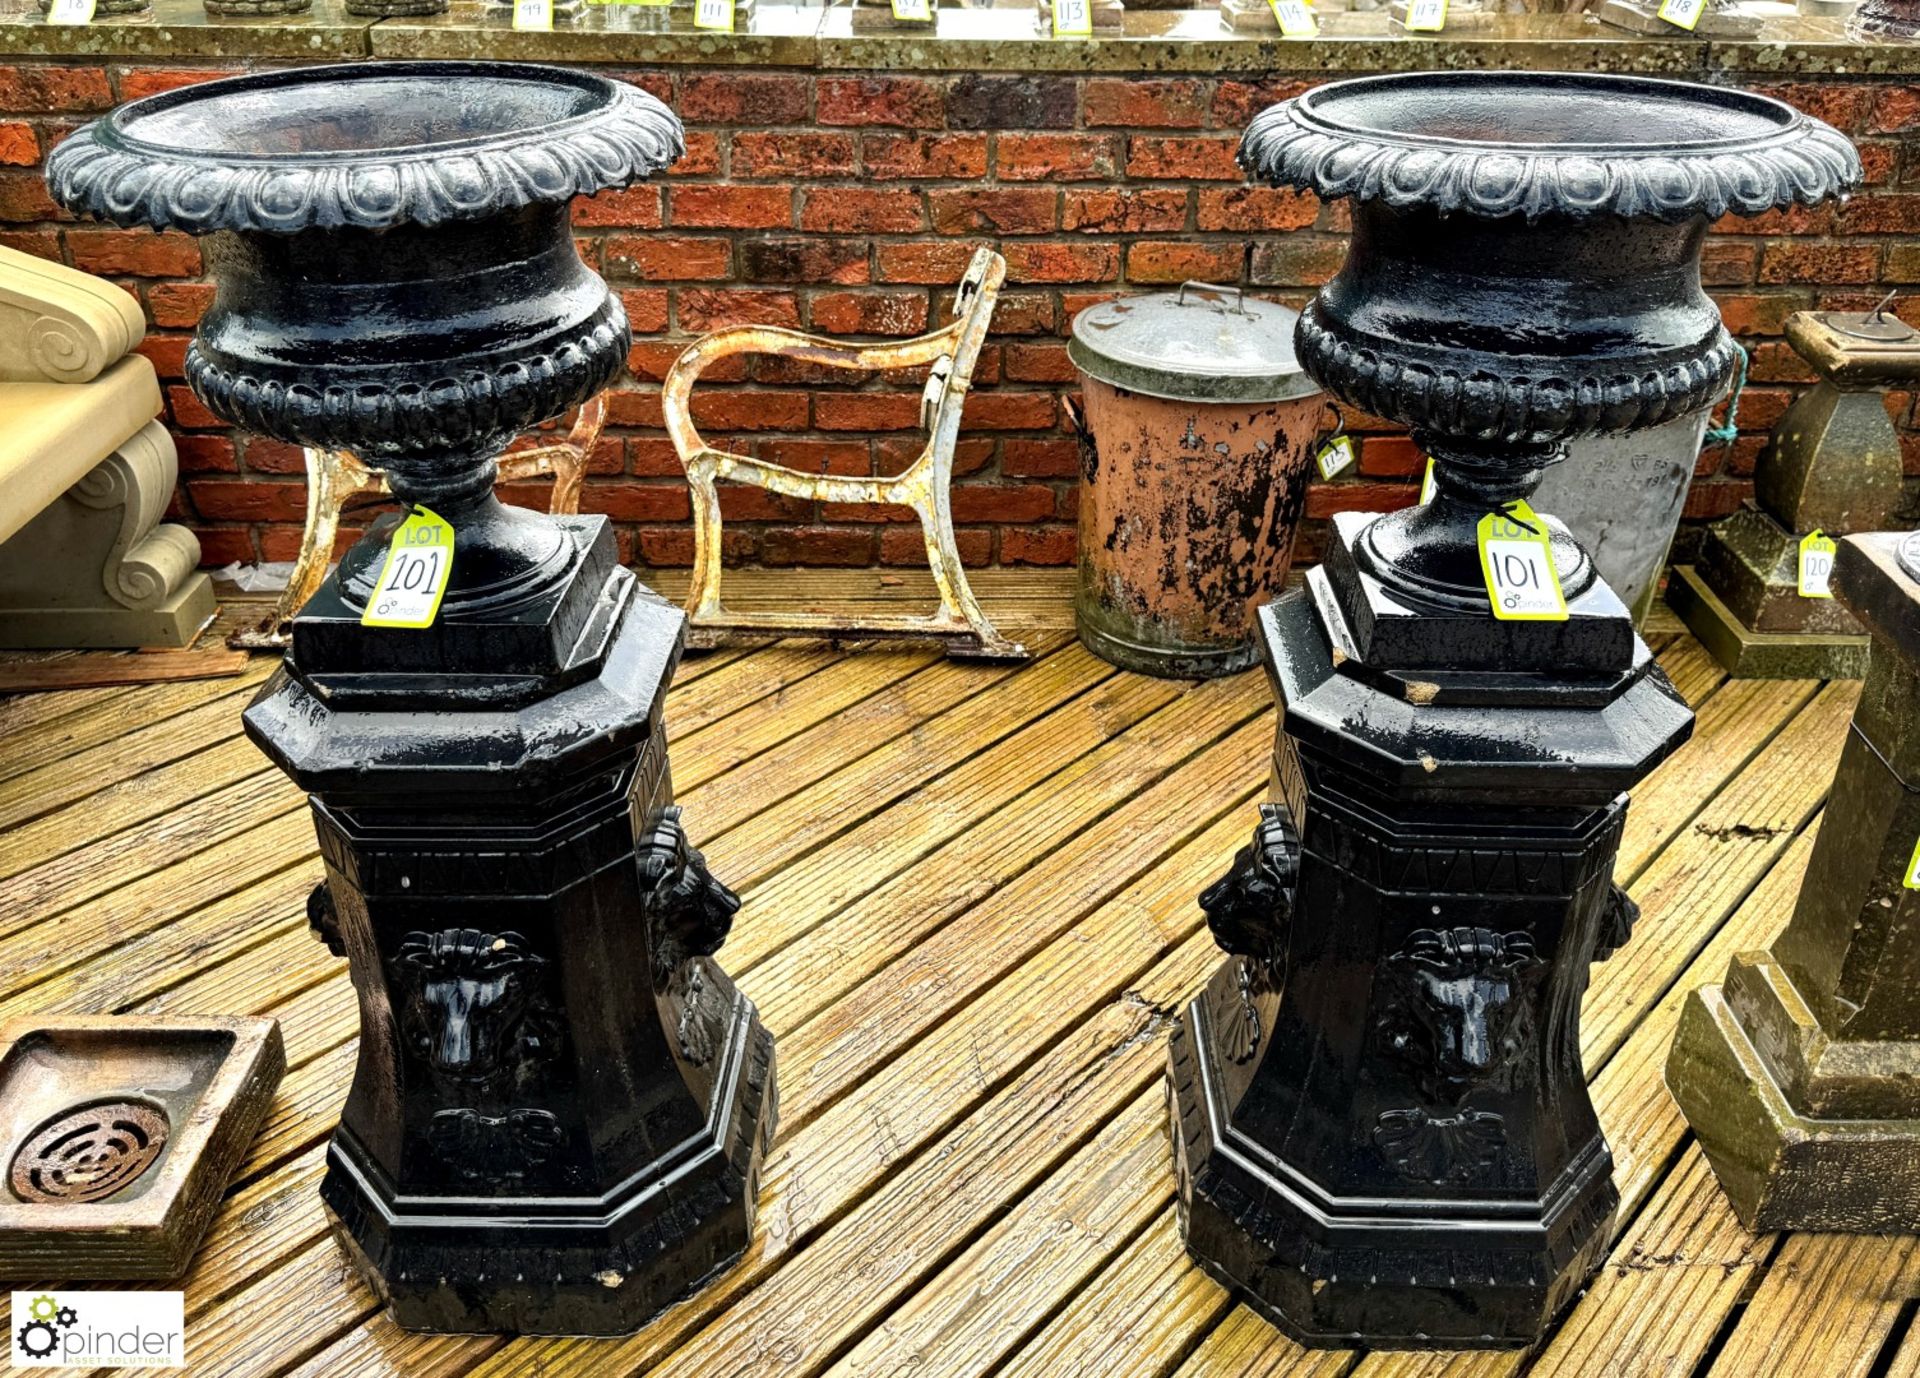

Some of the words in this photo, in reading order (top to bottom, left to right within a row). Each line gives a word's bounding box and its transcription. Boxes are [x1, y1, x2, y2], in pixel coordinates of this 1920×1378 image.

[521, 4, 541, 16] 99
[703, 3, 722, 17] 111
[1060, 2, 1082, 20] 113
[1277, 4, 1303, 21] 114
[1415, 3, 1440, 17] 117
[405, 525, 443, 545] LOT
[1492, 519, 1536, 538] LOT
[1807, 540, 1829, 551] LOT
[386, 552, 438, 595] 101
[1492, 552, 1539, 590] 101
[1806, 557, 1829, 576] 120
